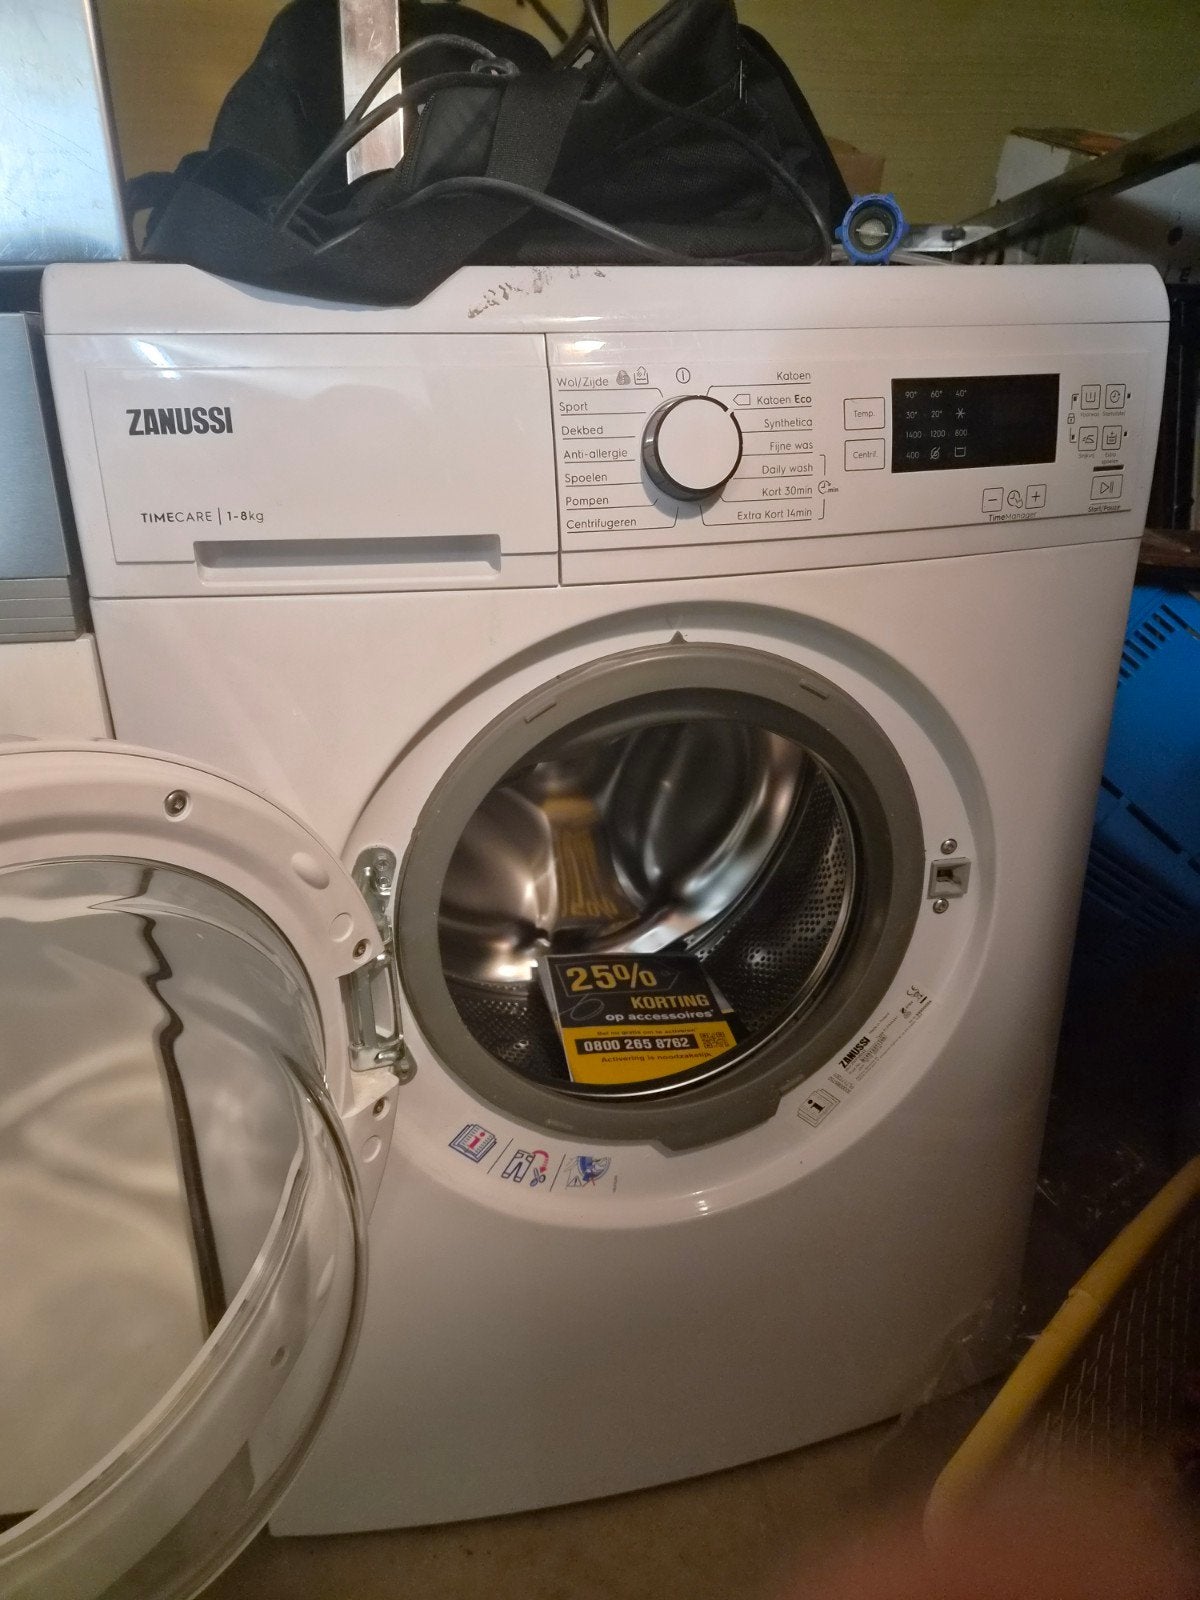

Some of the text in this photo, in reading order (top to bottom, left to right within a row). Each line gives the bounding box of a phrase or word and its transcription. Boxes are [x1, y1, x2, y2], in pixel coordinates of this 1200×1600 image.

[556, 376, 609, 388] Wol/Zijde
[776, 371, 811, 381] Katoen
[756, 393, 812, 406] Katoen Eco
[559, 401, 588, 413] Sport
[126, 406, 234, 436] ZANUSSI
[764, 417, 813, 430] Synthetica
[561, 425, 604, 436] Dekbed
[930, 429, 946, 438] 1200
[769, 441, 814, 453] Fijne was
[563, 448, 628, 461] Anti-allergie
[761, 463, 813, 476] Daily wash
[564, 473, 608, 484] Spoelen
[762, 485, 813, 497] Kort 30min
[565, 495, 609, 507] Pompen
[140, 509, 265, 524] TIMECARE 1-8kg
[737, 507, 812, 521] Extra Kort 14min
[566, 517, 637, 530] Centrifugeren
[566, 962, 658, 992] 25%
[630, 994, 710, 1010] KORTING
[605, 1013, 625, 1023] op
[583, 1037, 690, 1052] 0800 265 8762
[838, 1036, 871, 1069] ZANUSSI
